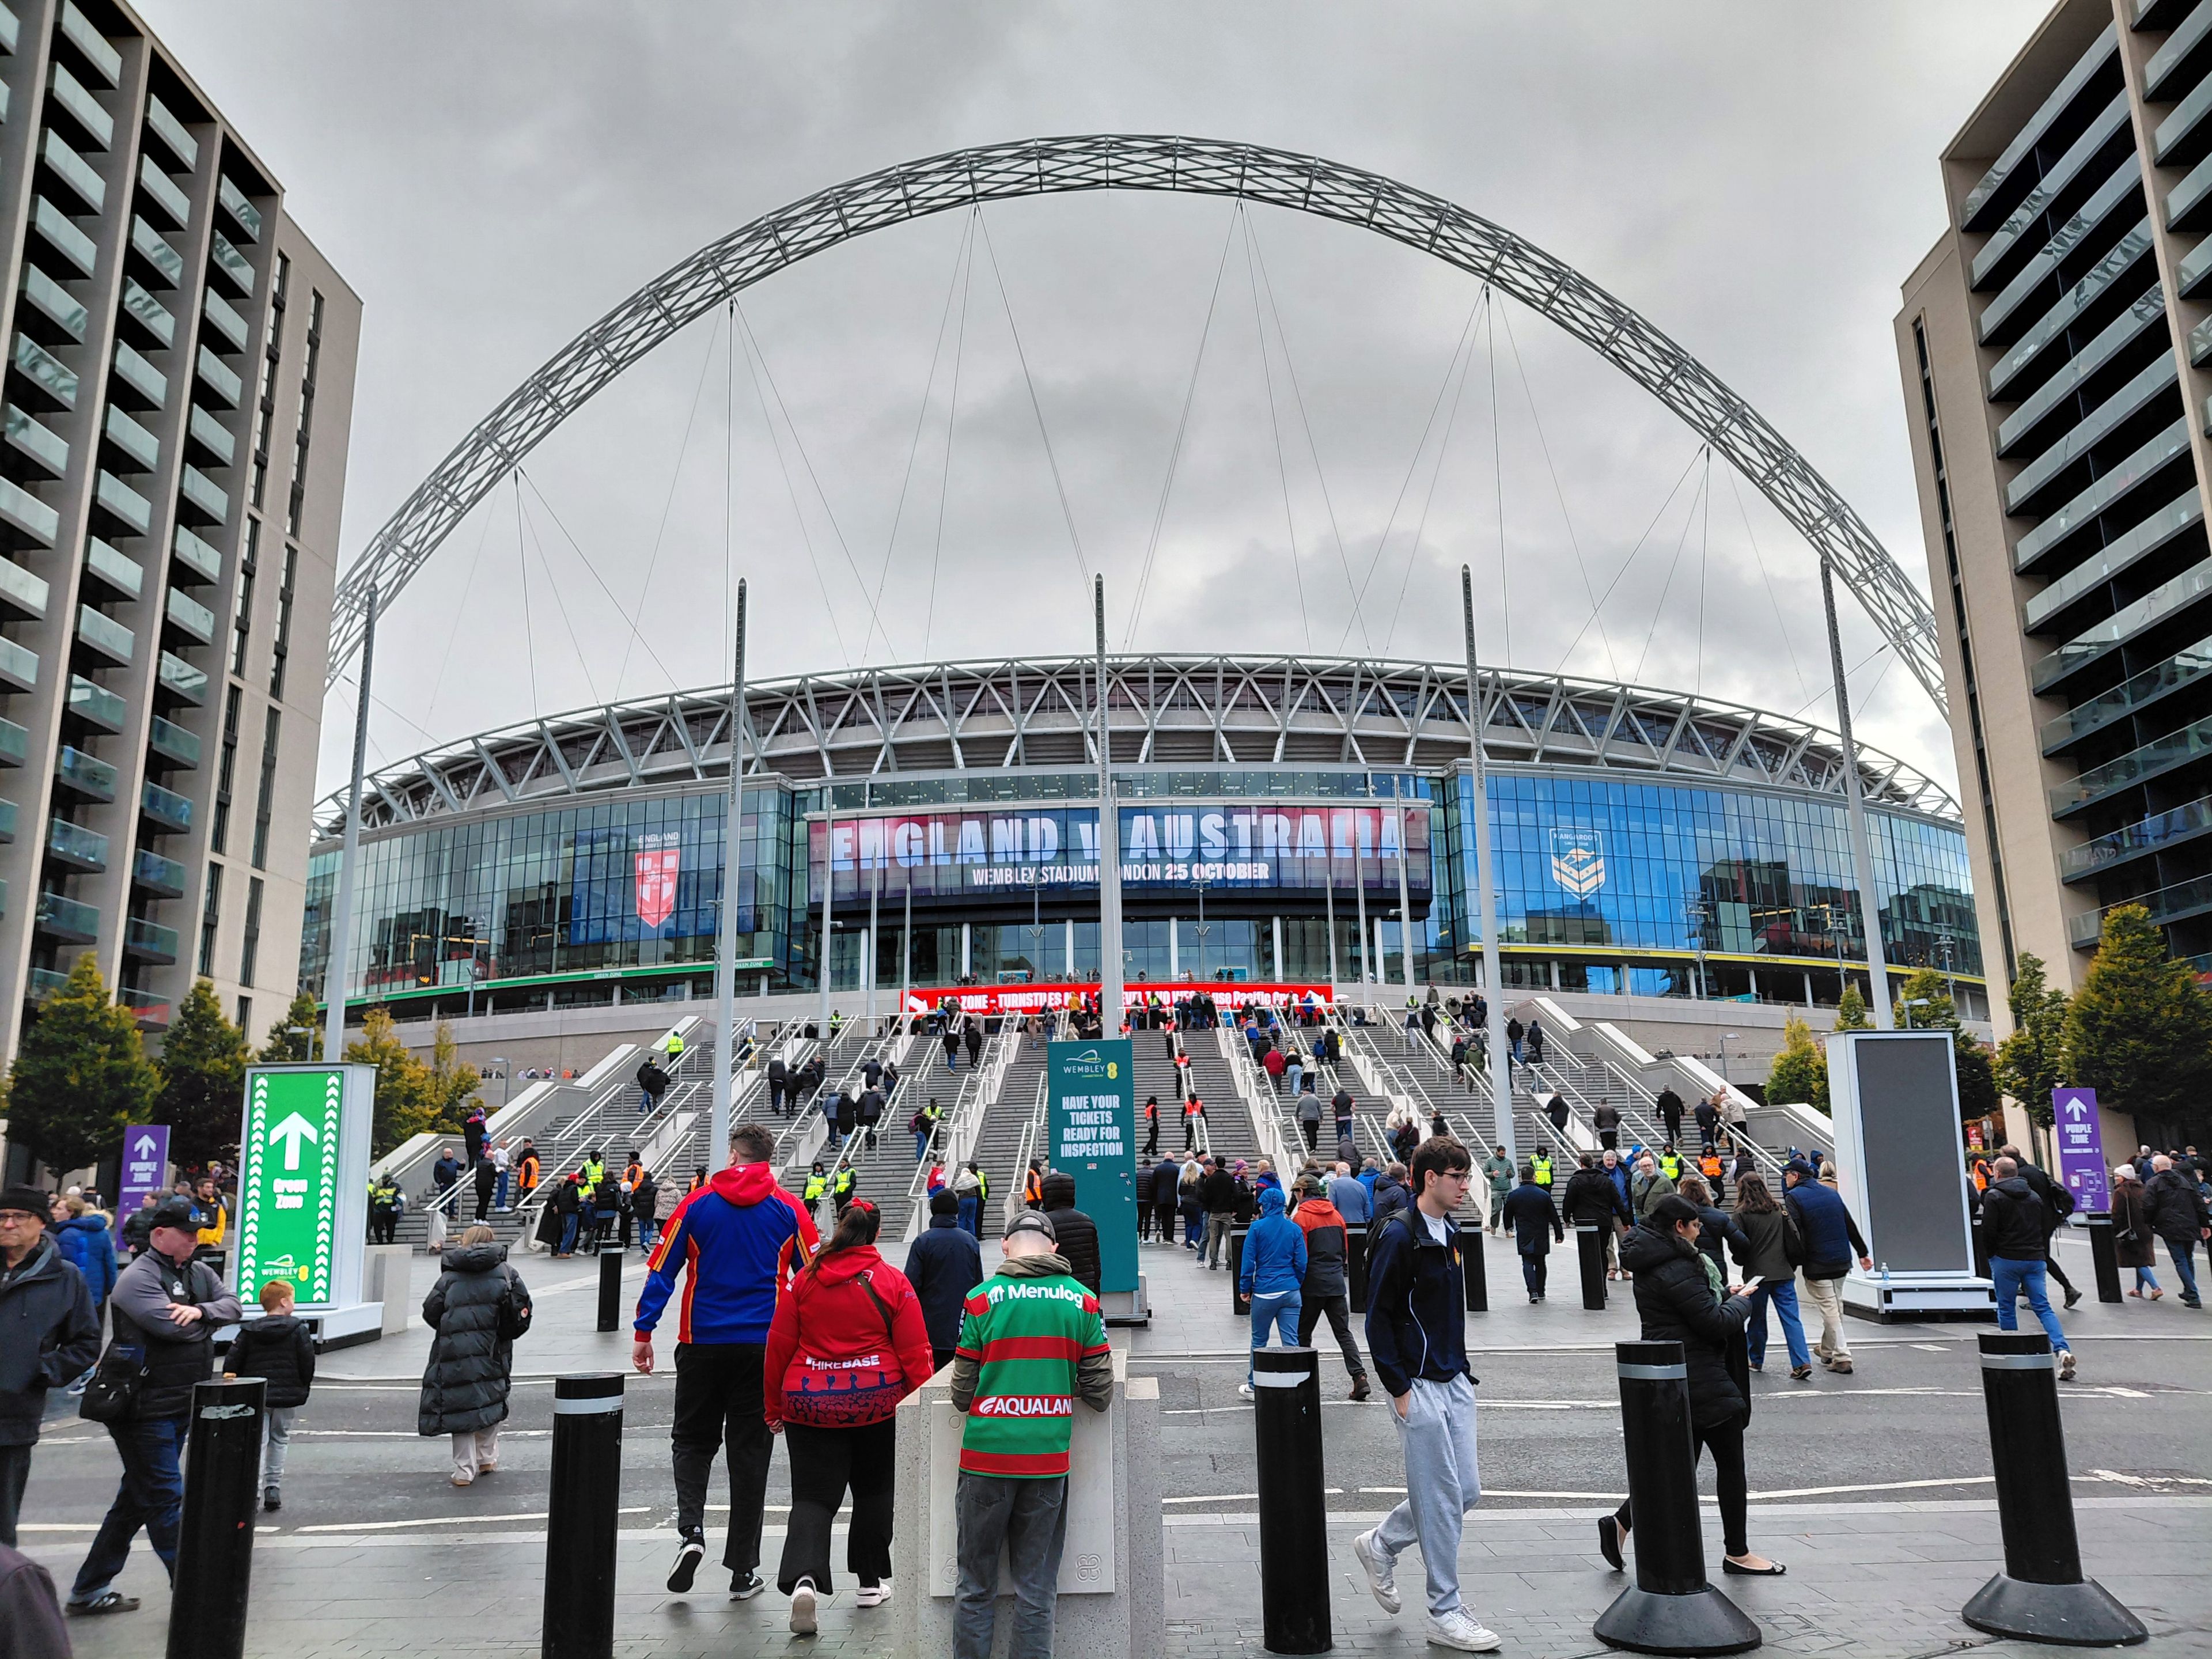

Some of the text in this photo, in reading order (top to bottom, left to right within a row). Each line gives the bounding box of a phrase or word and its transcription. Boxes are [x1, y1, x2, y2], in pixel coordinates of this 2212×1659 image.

[638, 831, 679, 843] ENGLAND
[832, 817, 1059, 872] ENGLAND
[1128, 813, 1410, 859] AUSTRALIA
[972, 866, 1036, 886] WEMBLEY
[1165, 862, 1189, 880] 25
[1191, 862, 1270, 880] OCTOBER
[960, 995, 988, 1010] ZONE
[997, 992, 1063, 1009] TURNSTILES
[1211, 992, 1232, 1006] use
[1233, 991, 1271, 1007] Pacific
[1063, 1065, 1105, 1074] WEMBLEY
[1062, 1094, 1120, 1110] HAVE YOUR
[1069, 1111, 1113, 1126] TICKETS
[1063, 1126, 1120, 1142] READY FOR
[2065, 1124, 2092, 1134] PURPLE
[2070, 1134, 2090, 1144] ZONE
[1060, 1142, 1123, 1157] INSPECTION
[272, 1177, 308, 1194] Green
[275, 1194, 304, 1210] Zone
[1007, 1283, 1084, 1309] Menulog
[812, 1355, 880, 1371] HIREBASE
[993, 1397, 1072, 1416] AQUALAN
